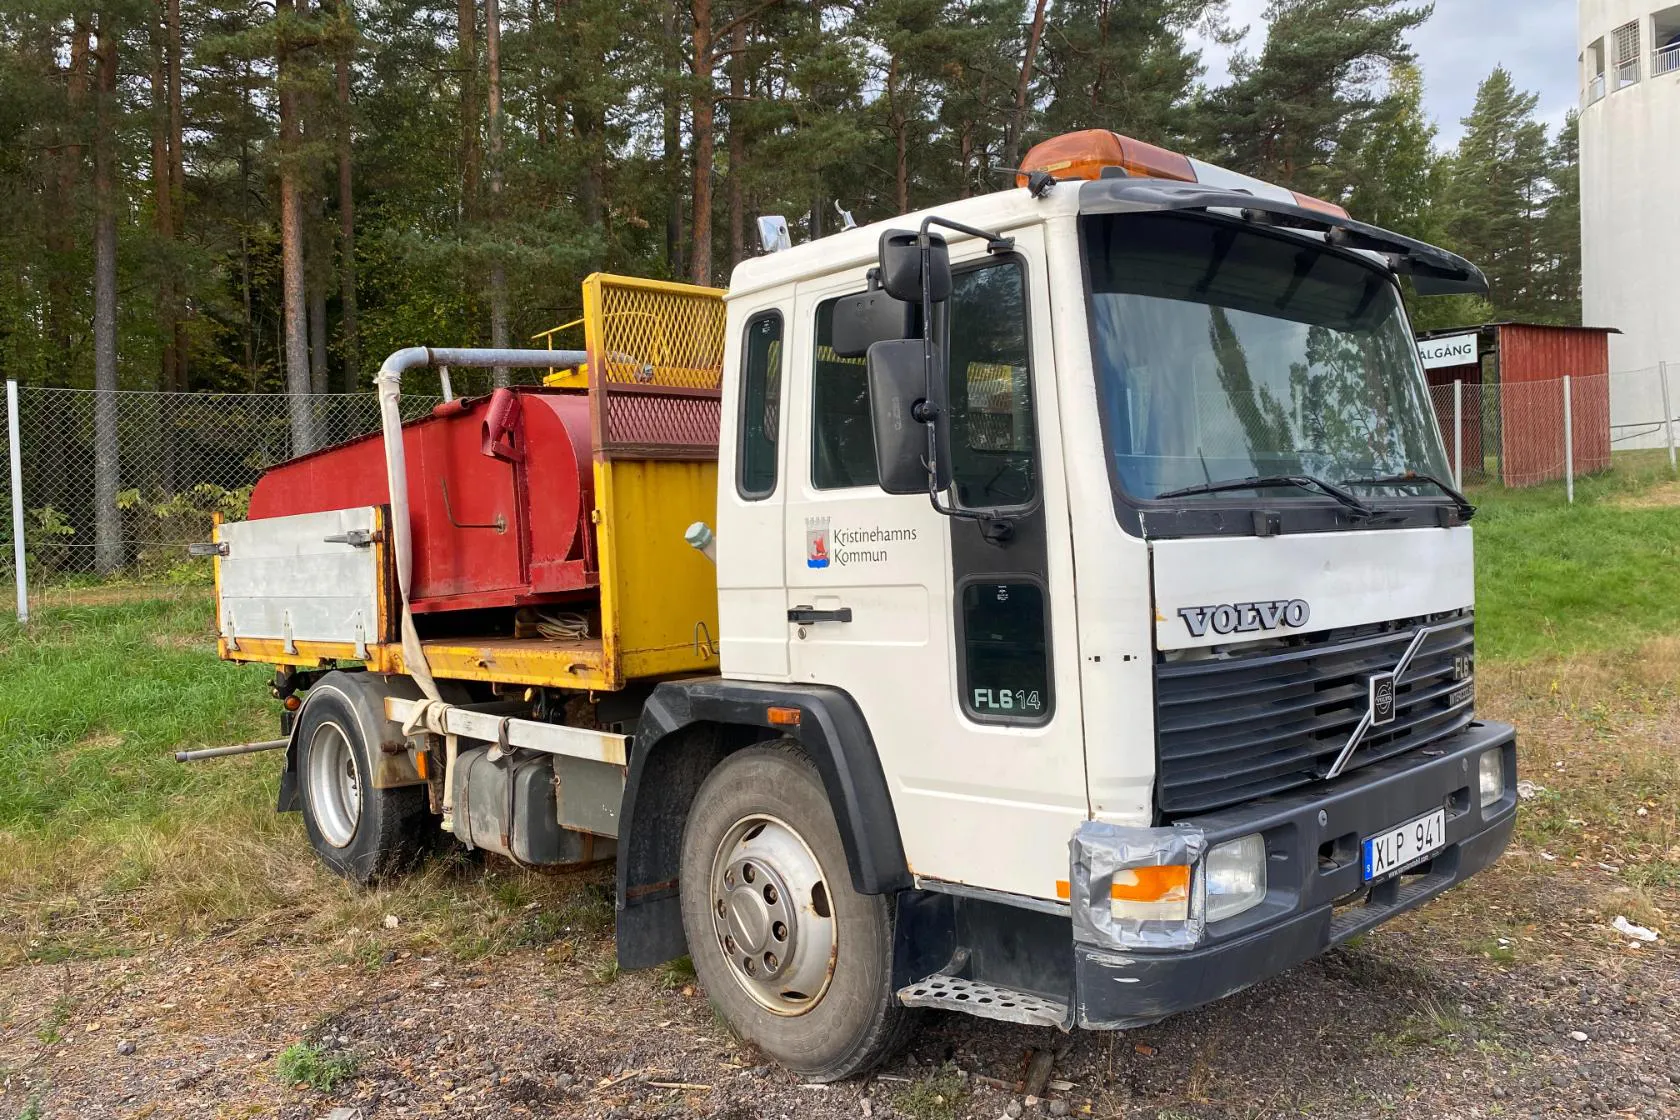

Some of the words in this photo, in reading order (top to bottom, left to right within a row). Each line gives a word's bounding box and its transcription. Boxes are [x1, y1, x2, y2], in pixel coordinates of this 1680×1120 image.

[1420, 344, 1472, 360] ÅLGÅNG
[833, 525, 918, 547] Kristinehamns
[833, 548, 888, 567] Kommun
[1177, 598, 1311, 638] VOLVO
[974, 688, 1013, 709] FL6
[1015, 689, 1041, 710] 14
[1375, 831, 1404, 872] XLP
[1415, 814, 1442, 852] 941
[1366, 864, 1371, 873] S
